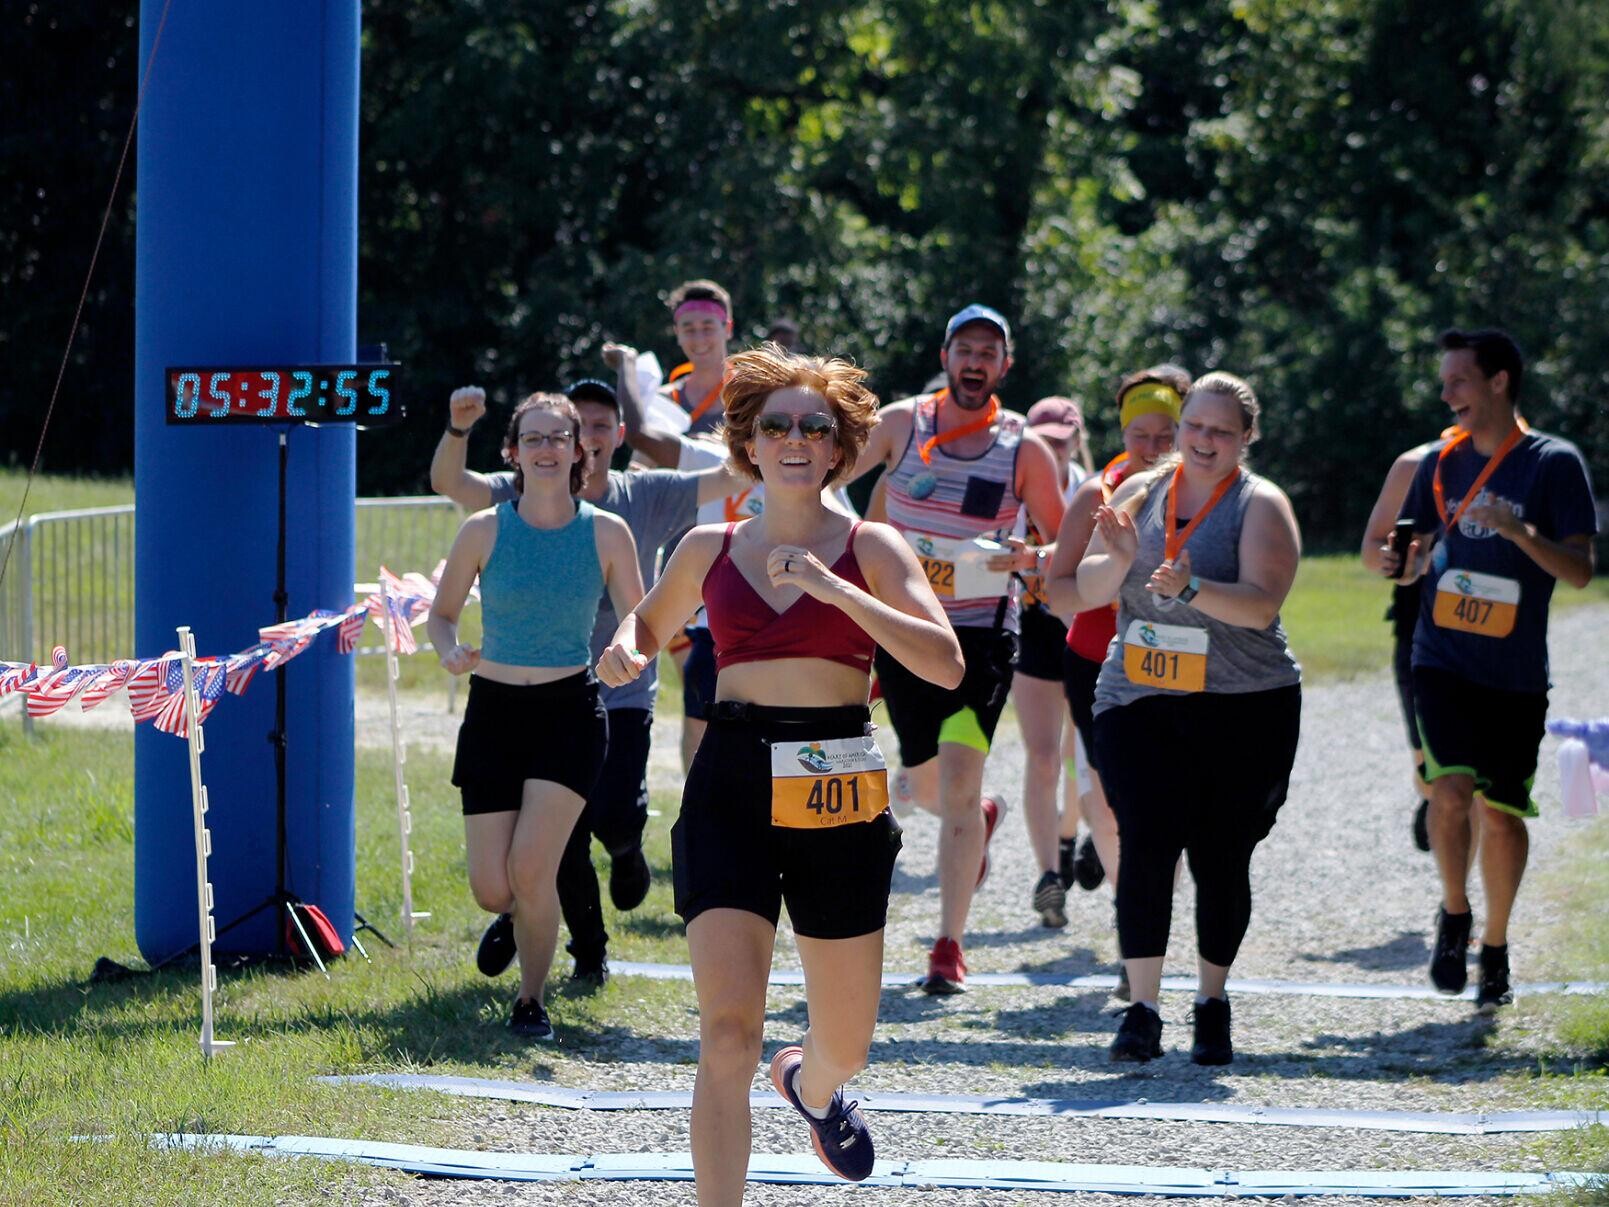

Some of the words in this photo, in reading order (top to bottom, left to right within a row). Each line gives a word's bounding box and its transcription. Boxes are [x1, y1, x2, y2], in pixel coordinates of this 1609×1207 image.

[174, 370, 390, 418] 05:32:55
[1453, 598, 1493, 625] 407
[1141, 650, 1178, 680] 401
[806, 776, 859, 815] 401
